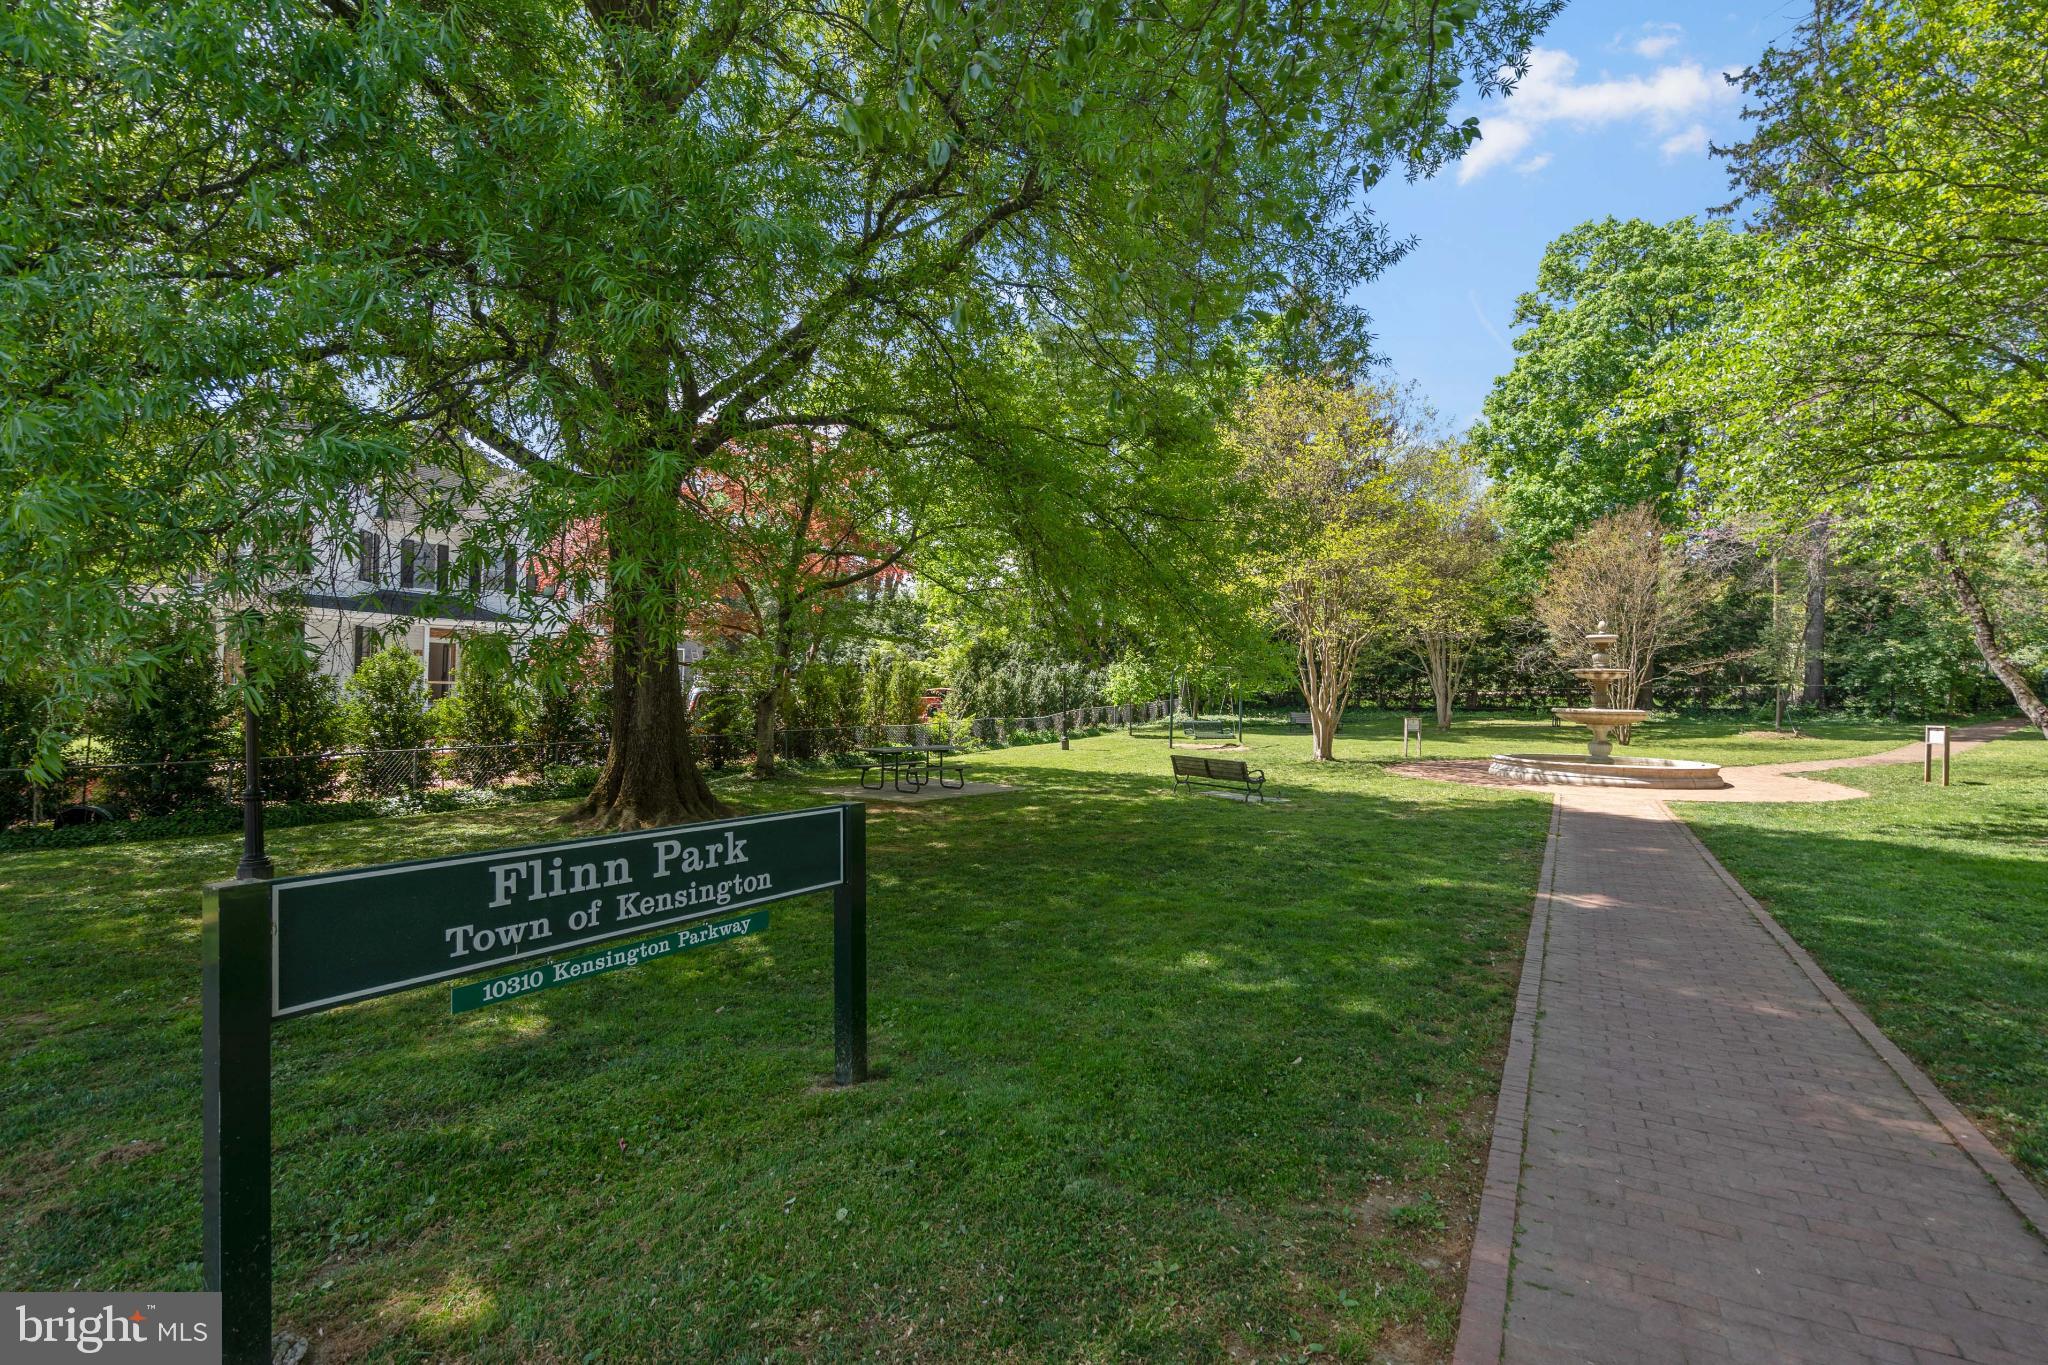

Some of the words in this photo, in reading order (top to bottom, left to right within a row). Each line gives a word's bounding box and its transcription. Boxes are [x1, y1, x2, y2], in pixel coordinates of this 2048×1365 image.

[488, 857, 632, 908] Flinn
[652, 831, 749, 879] Park
[445, 917, 552, 958] Town
[568, 900, 603, 929] of
[616, 870, 773, 921] Kensington
[482, 970, 544, 1002] 10310
[552, 939, 670, 982] Kensington
[677, 917, 752, 948] Parkway
